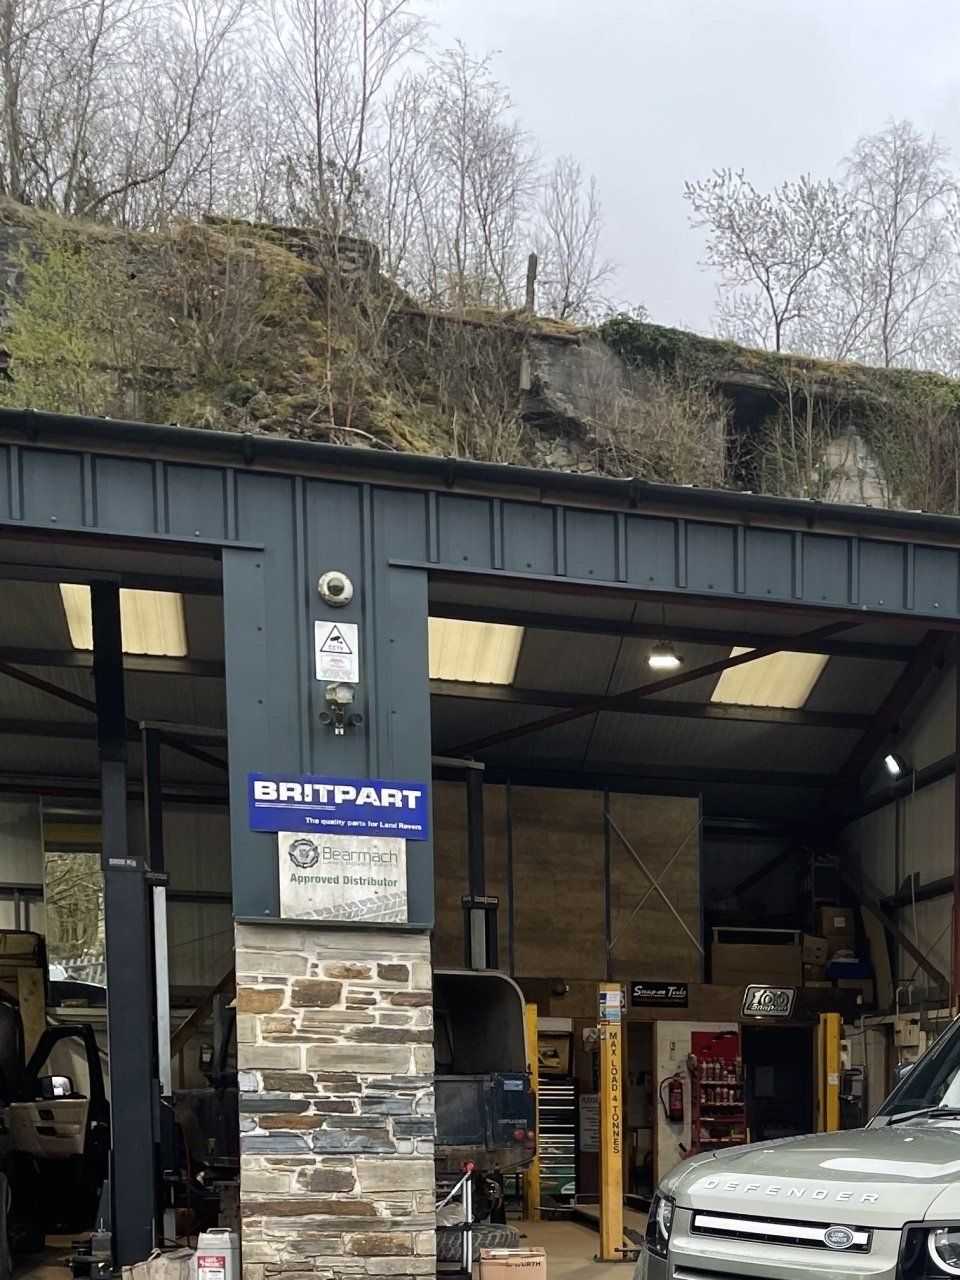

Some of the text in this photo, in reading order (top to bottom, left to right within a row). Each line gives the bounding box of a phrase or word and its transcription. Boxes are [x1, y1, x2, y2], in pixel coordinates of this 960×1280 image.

[254, 781, 421, 808] BRITPART
[321, 819, 346, 827] quality
[347, 819, 366, 827] parts
[380, 821, 398, 829] Land
[399, 823, 422, 831] Rovers
[322, 846, 398, 862] Bearmach
[290, 872, 398, 888] Approved Distributor
[633, 986, 687, 997] Snap-on Tools
[609, 1032, 620, 1154] MAX LOAD 4 TONNES
[704, 1178, 879, 1204] DEFENDER
